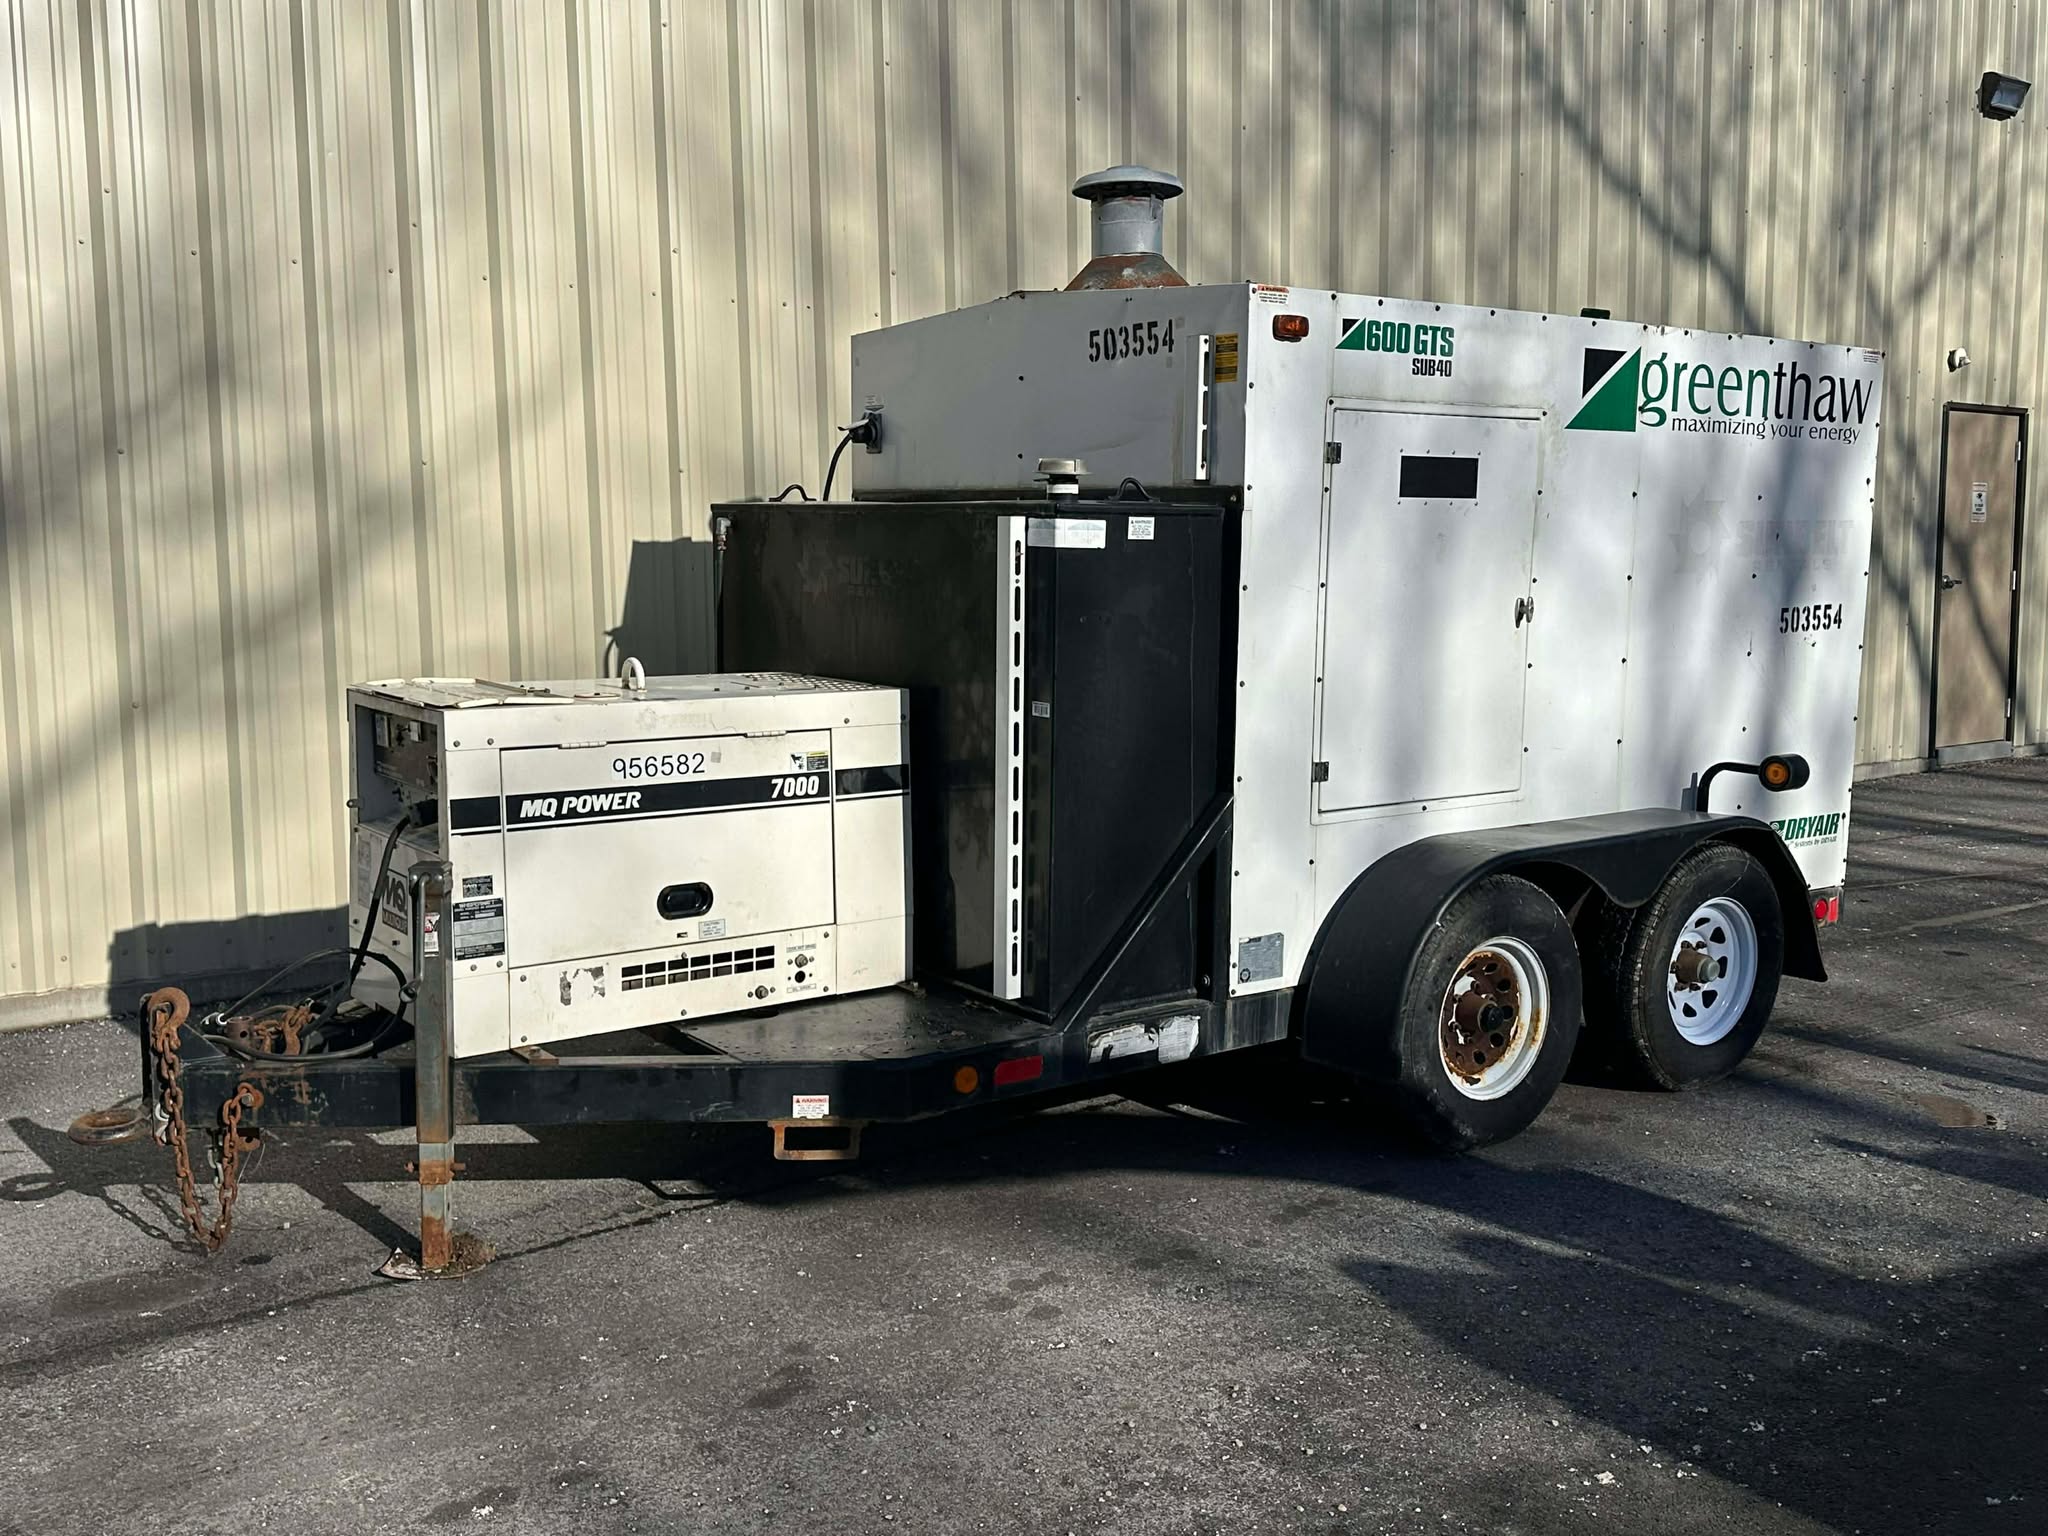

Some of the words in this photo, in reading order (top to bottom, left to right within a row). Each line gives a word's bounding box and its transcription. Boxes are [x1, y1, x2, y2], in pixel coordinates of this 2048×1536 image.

[1088, 319, 1175, 363] 503554
[1366, 320, 1411, 354] 600
[1414, 324, 1455, 357] GTS
[1412, 358, 1453, 377] SUB40
[1641, 352, 1873, 427] greenthaw
[1671, 416, 1766, 439] maximizing
[1770, 422, 1804, 440] your
[1808, 425, 1861, 445] energy
[1779, 603, 1842, 634] 503554
[612, 753, 706, 779] 956582
[770, 776, 820, 799] 7000
[520, 798, 558, 819] MQ
[561, 791, 642, 815] POWER
[1785, 813, 1841, 840] DRYAIR
